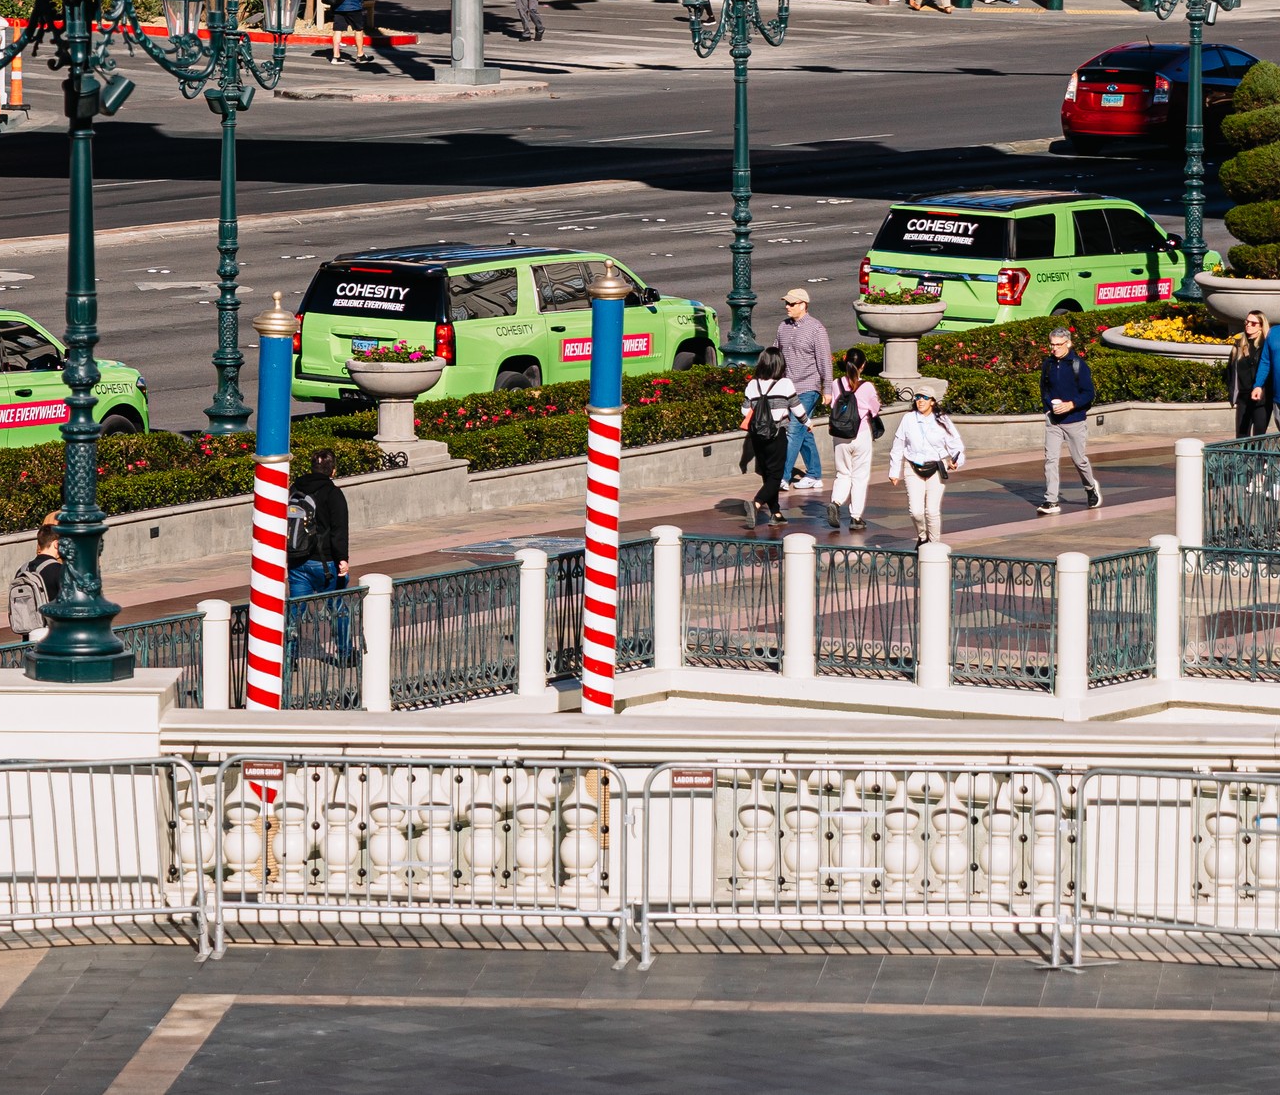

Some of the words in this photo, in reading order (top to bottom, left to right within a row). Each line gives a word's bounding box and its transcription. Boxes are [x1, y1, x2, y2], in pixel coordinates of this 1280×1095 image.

[907, 218, 979, 235] COHESITY
[934, 234, 975, 245] EVERYWHERE
[1036, 271, 1070, 283] COHESITY
[336, 282, 410, 301] COHESITY
[1098, 286, 1131, 299] RESILIENCE
[1131, 282, 1170, 298] EVERERE
[332, 298, 364, 308] RESILIENCE
[364, 299, 405, 312] EVERYWHERE
[495, 324, 534, 337] COHESITY
[95, 383, 135, 395] COHESITY
[15, 403, 67, 423] EVERYWHERE
